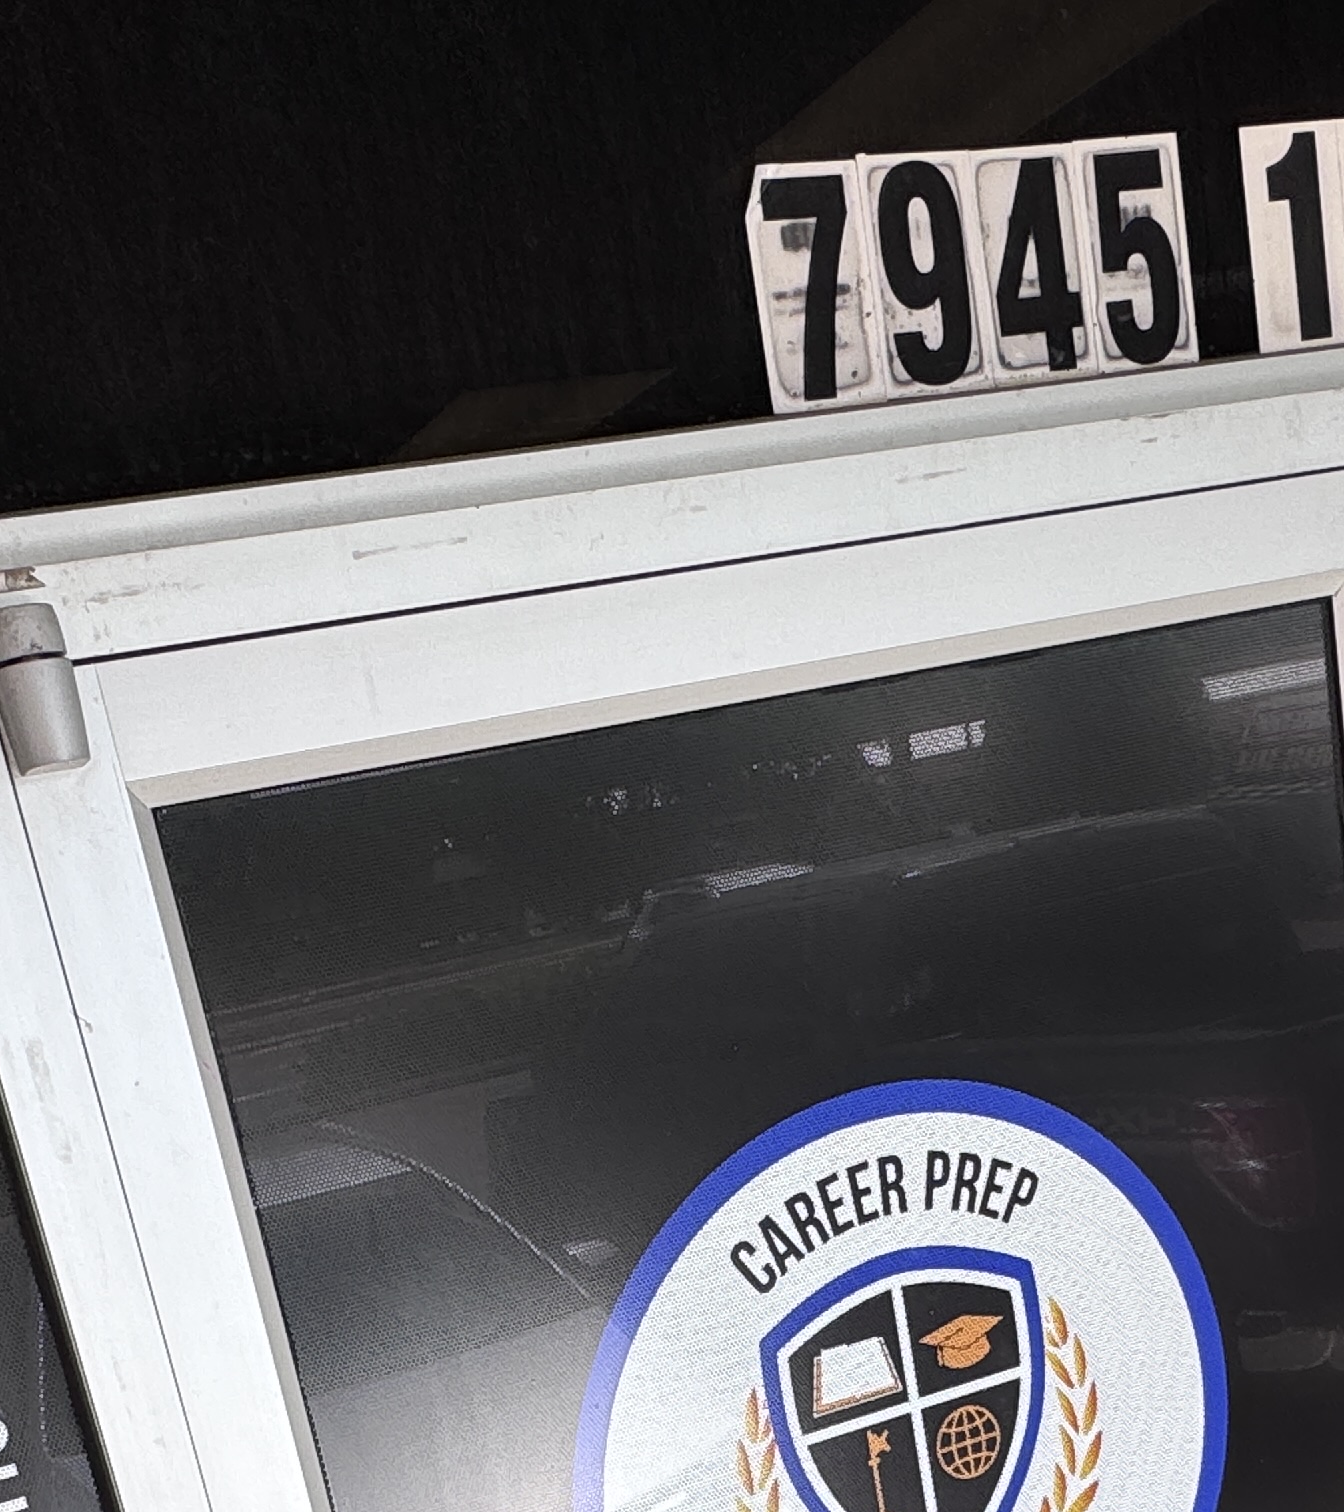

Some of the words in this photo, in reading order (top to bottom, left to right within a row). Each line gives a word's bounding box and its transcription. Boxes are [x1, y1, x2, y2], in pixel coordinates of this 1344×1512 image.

[760, 148, 1181, 401] 7945
[729, 1154, 906, 1295] CAREER
[923, 1150, 1039, 1225] PREP
